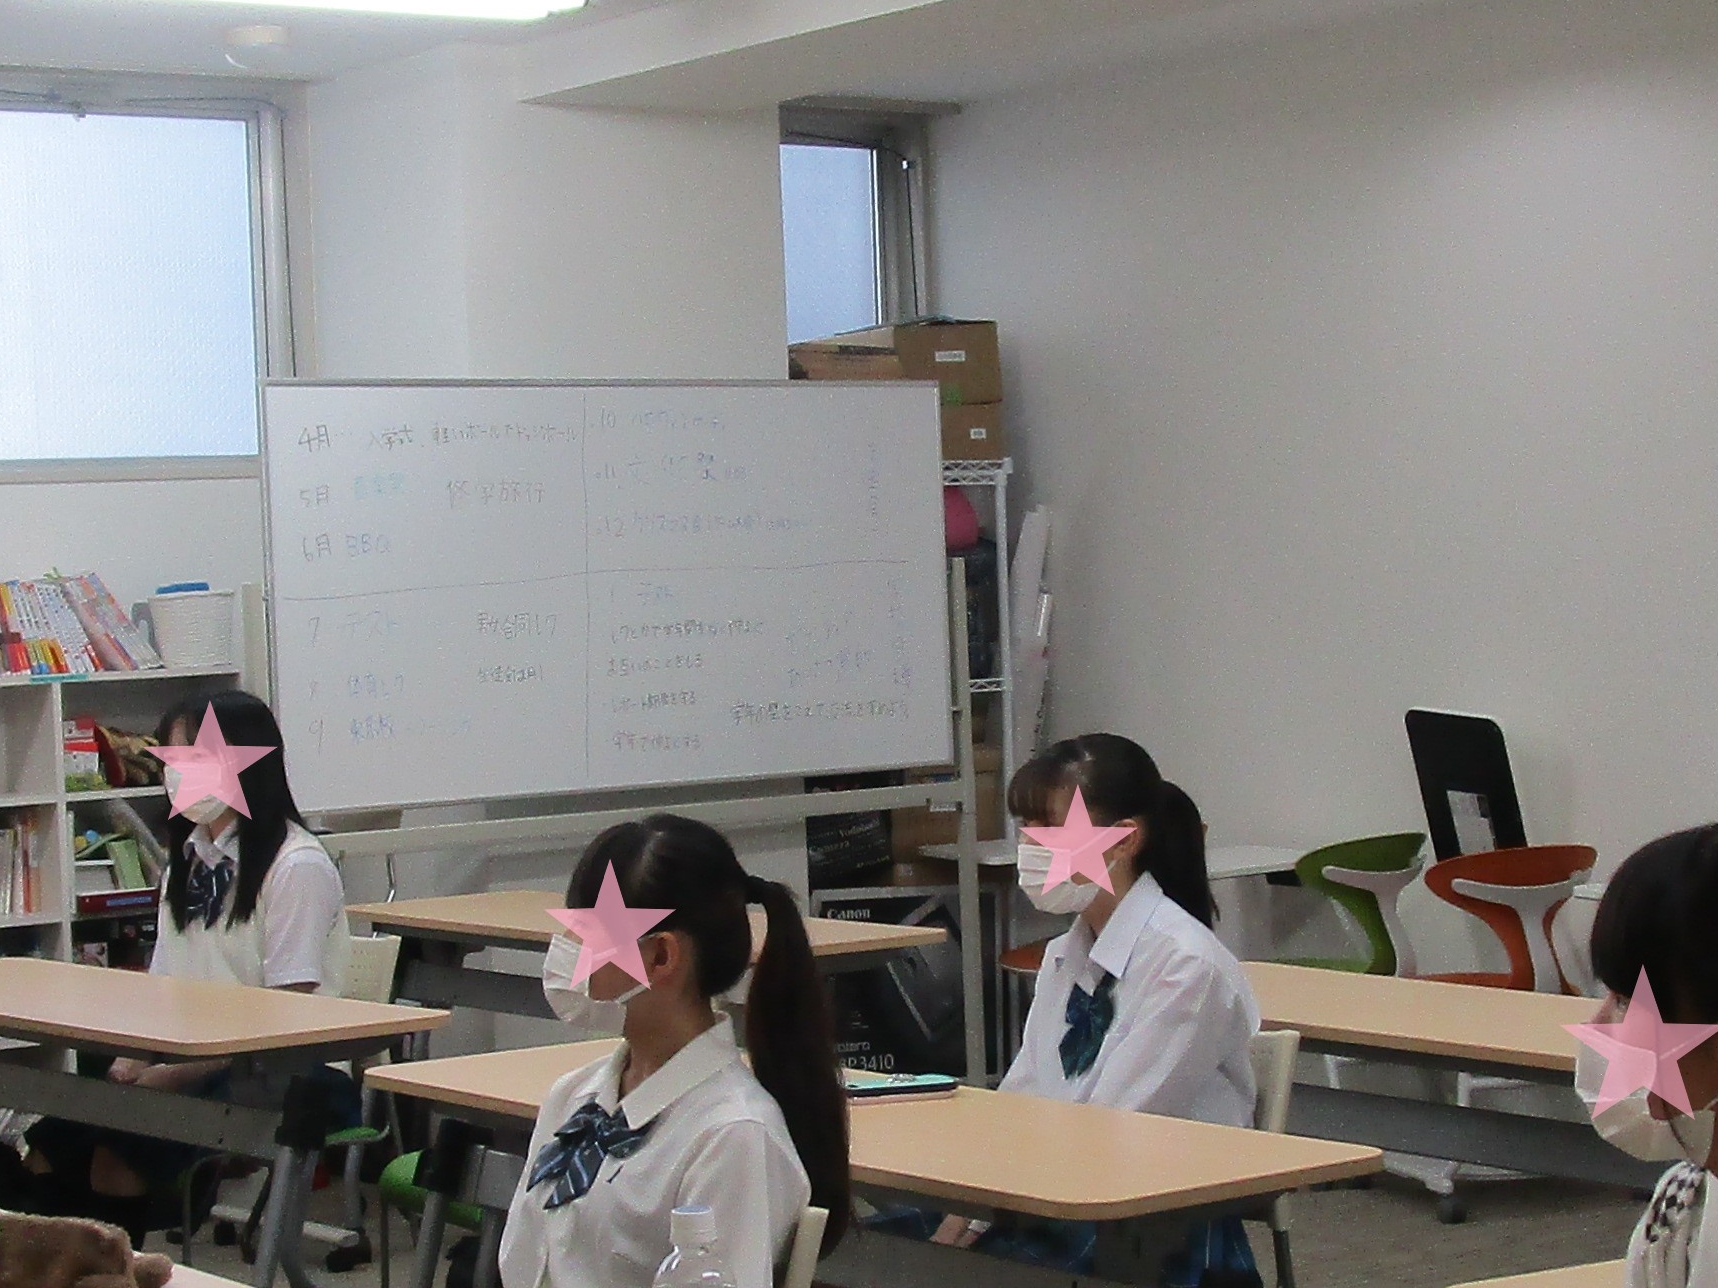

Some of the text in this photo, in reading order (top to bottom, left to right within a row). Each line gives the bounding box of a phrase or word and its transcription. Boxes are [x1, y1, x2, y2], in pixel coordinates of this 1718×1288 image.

[297, 423, 331, 453] 4月
[298, 485, 330, 509] 5月
[445, 480, 547, 510] 修学旅行
[302, 532, 334, 564] 6月
[345, 533, 393, 559] BBQ
[826, 907, 871, 920] Canon
